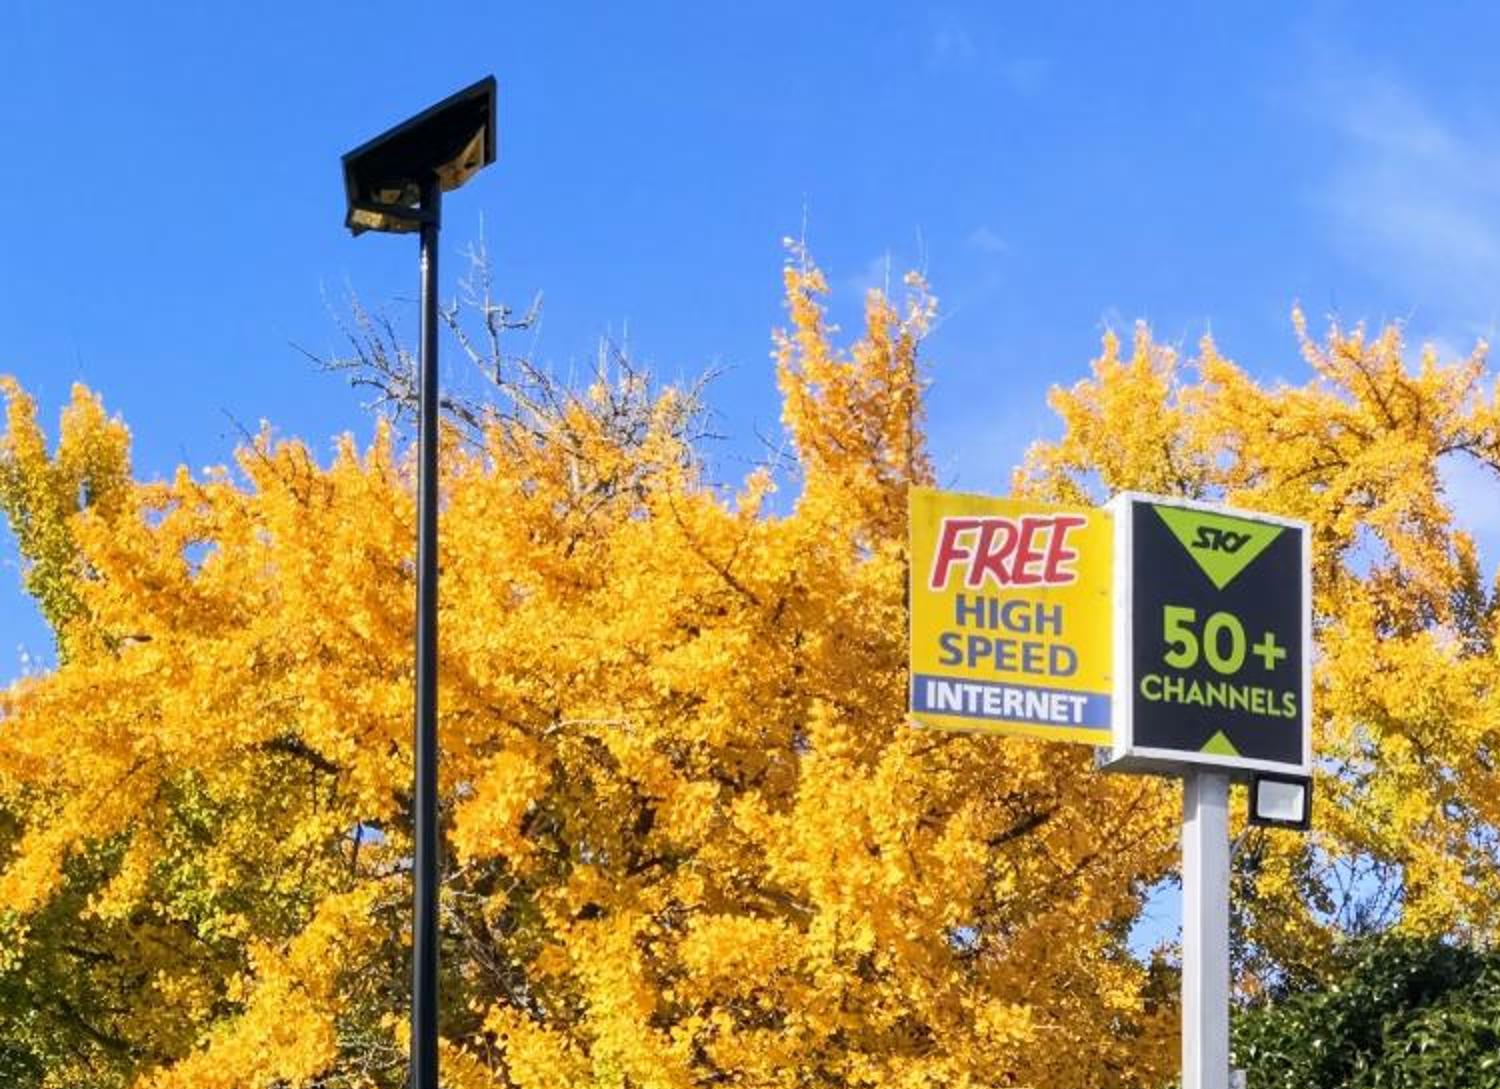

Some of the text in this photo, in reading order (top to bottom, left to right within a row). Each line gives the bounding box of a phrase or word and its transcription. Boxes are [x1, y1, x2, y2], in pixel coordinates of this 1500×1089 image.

[931, 517, 1086, 588] FREE
[1191, 525, 1253, 554] SKY
[955, 594, 1063, 636] HIGH
[938, 632, 1078, 677] SPEED
[1163, 604, 1287, 675] 50+
[926, 680, 1087, 723] INTERNET
[1140, 674, 1297, 718] CHANNELS
